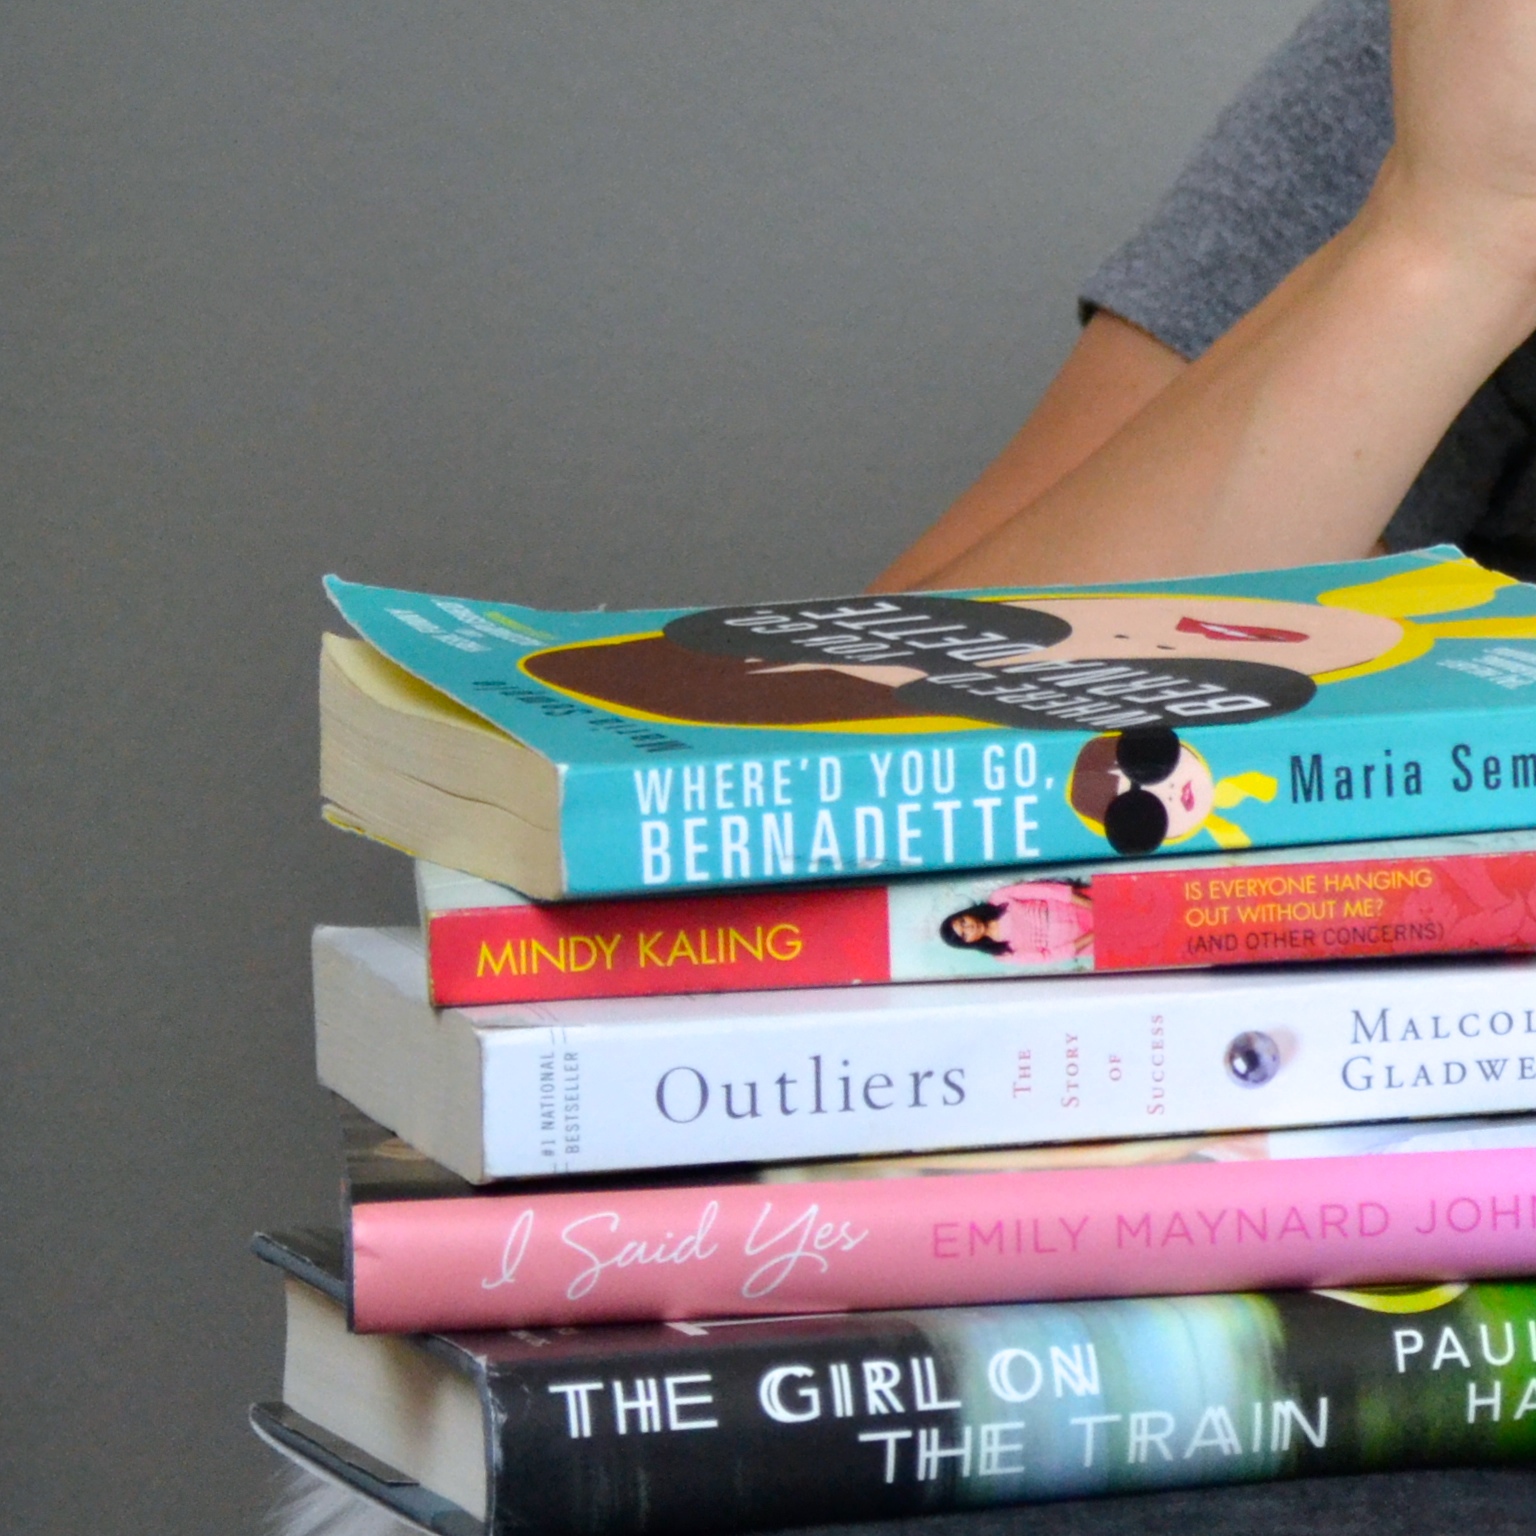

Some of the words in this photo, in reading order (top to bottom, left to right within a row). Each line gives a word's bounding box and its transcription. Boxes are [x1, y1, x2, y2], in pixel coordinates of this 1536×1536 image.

[870, 747, 957, 796] YOU
[983, 742, 1057, 793] GO,
[1289, 748, 1424, 804] Maria
[640, 795, 1041, 885] BERNADETTE
[1185, 878, 1203, 903] IS
[1208, 873, 1321, 900] EVERYONE
[1325, 868, 1434, 893] HANGING
[1186, 904, 1231, 929] OUT
[1237, 899, 1335, 925] WITHOUT
[1342, 895, 1386, 919] ME?
[476, 934, 623, 980] MINDY
[638, 924, 804, 971] KALING
[1186, 929, 1241, 956] (AND
[1246, 926, 1317, 951] OTHER
[1324, 920, 1445, 949] CONCERNS)
[539, 1050, 555, 1126] NATIONAL
[564, 1049, 582, 1156] BESTSELLER
[655, 1054, 968, 1125] Outliers
[481, 1210, 535, 1289] I
[561, 1200, 721, 1301] Said
[741, 1201, 869, 1298] Yes
[933, 1215, 1092, 1259] EMILY
[1115, 1200, 1392, 1255] MAYNARD
[548, 1374, 720, 1439] THE
[758, 1358, 962, 1426] GIRL
[987, 1343, 1103, 1404] ON
[857, 1421, 1027, 1485] THE
[1070, 1396, 1330, 1470] TRAIN
